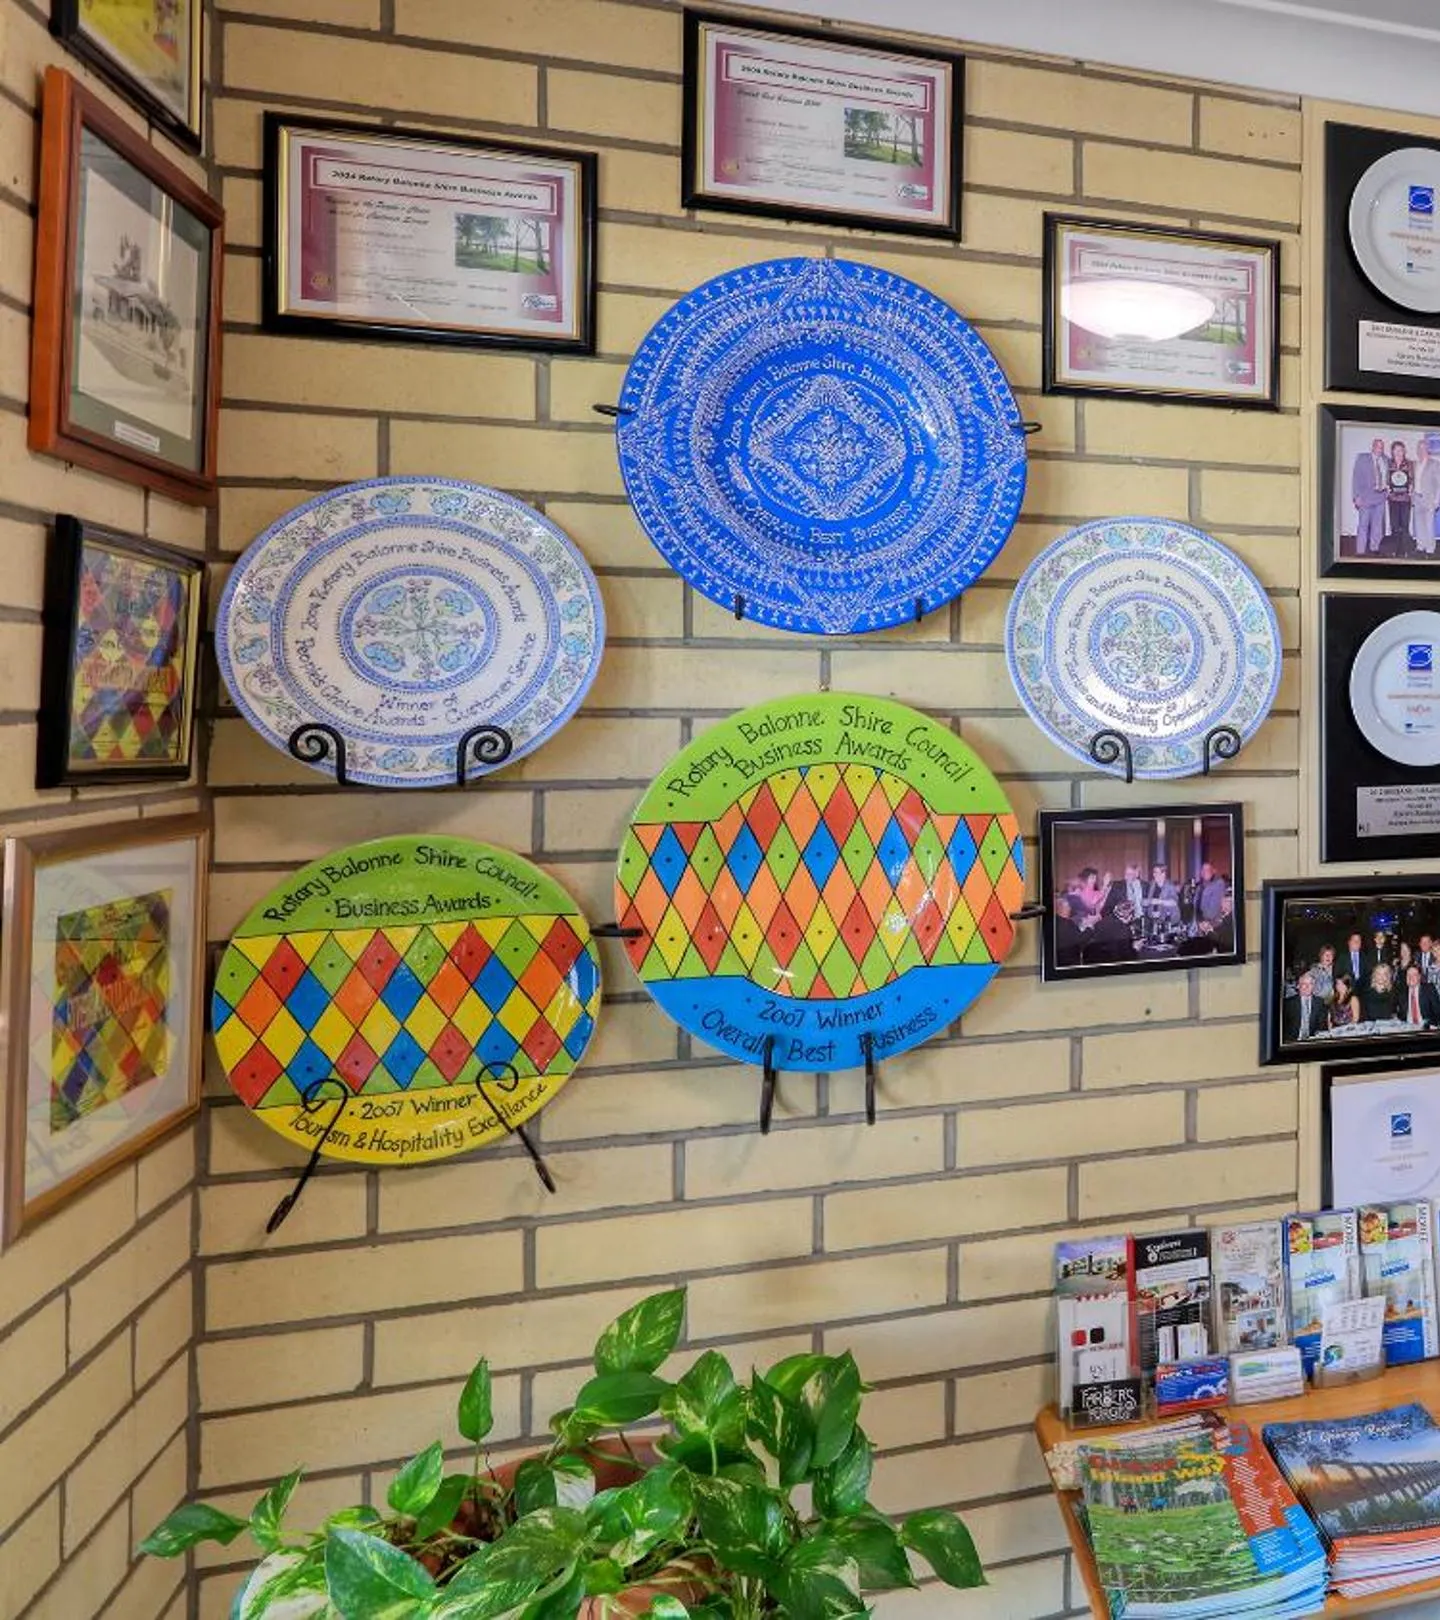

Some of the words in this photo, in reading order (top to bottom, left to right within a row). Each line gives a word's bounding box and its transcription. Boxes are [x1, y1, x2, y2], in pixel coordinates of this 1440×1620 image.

[667, 745, 734, 799] Rotary
[737, 707, 826, 745] Balonne
[839, 705, 895, 736] Shire
[905, 726, 973, 785] Council
[732, 736, 823, 780] Business
[835, 731, 912, 771] Awards
[262, 873, 331, 922] Rotary
[321, 851, 402, 886] Balonne
[415, 845, 468, 869] Shire
[475, 856, 538, 897] Council
[334, 898, 419, 919] Business
[421, 892, 491, 914] Awards
[757, 1001, 806, 1028] 2007
[816, 1001, 884, 1029] Winner
[787, 1039, 836, 1063] Best
[361, 1103, 403, 1120] 2007
[412, 1092, 479, 1115] Winner
[289, 1110, 350, 1147] Toursm
[353, 1132, 367, 1149] &
[368, 1126, 464, 1158] Hospitality
